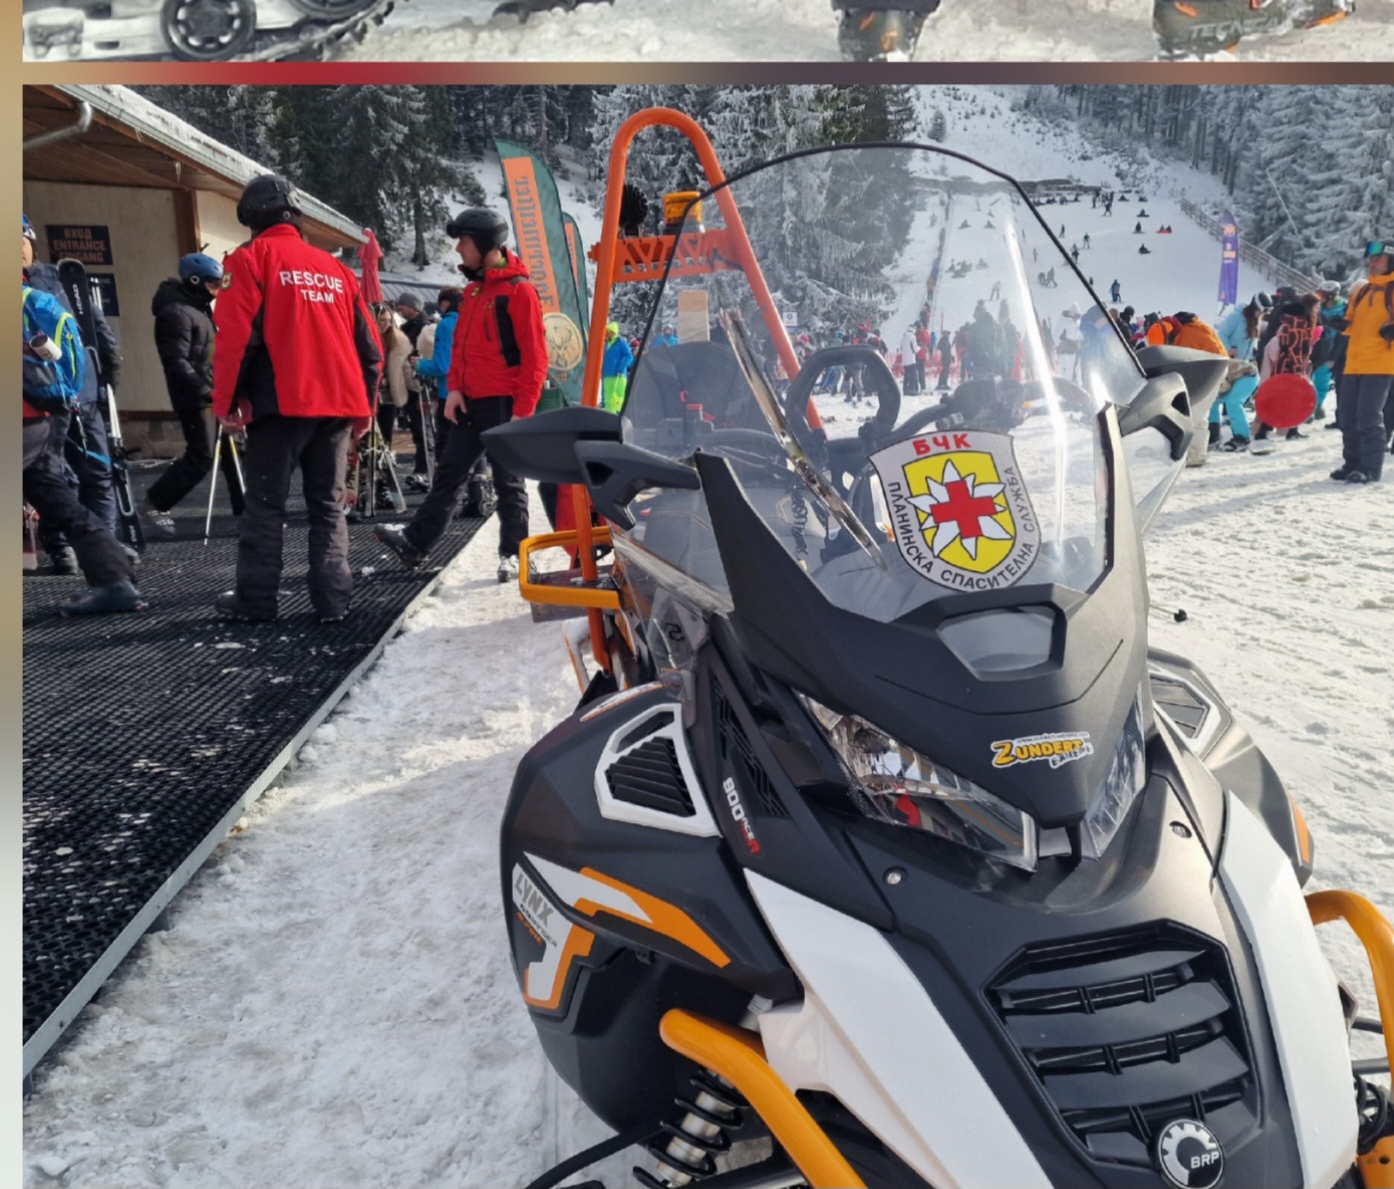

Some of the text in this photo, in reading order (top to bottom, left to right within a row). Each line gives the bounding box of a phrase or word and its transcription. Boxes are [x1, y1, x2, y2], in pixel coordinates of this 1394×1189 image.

[53, 239, 106, 252] ENTRANCE
[63, 228, 92, 240] ВХОД
[279, 270, 343, 294] RESCUE
[301, 289, 334, 304] TEAM
[912, 433, 972, 456] БЧК
[888, 466, 1036, 590] ПЛАНИНСКА СПАСИТЕЛНА СЛУЖБА
[992, 738, 1083, 766] ZUNDERT
[514, 872, 555, 928] LYNX
[1190, 1150, 1220, 1170] BRP
